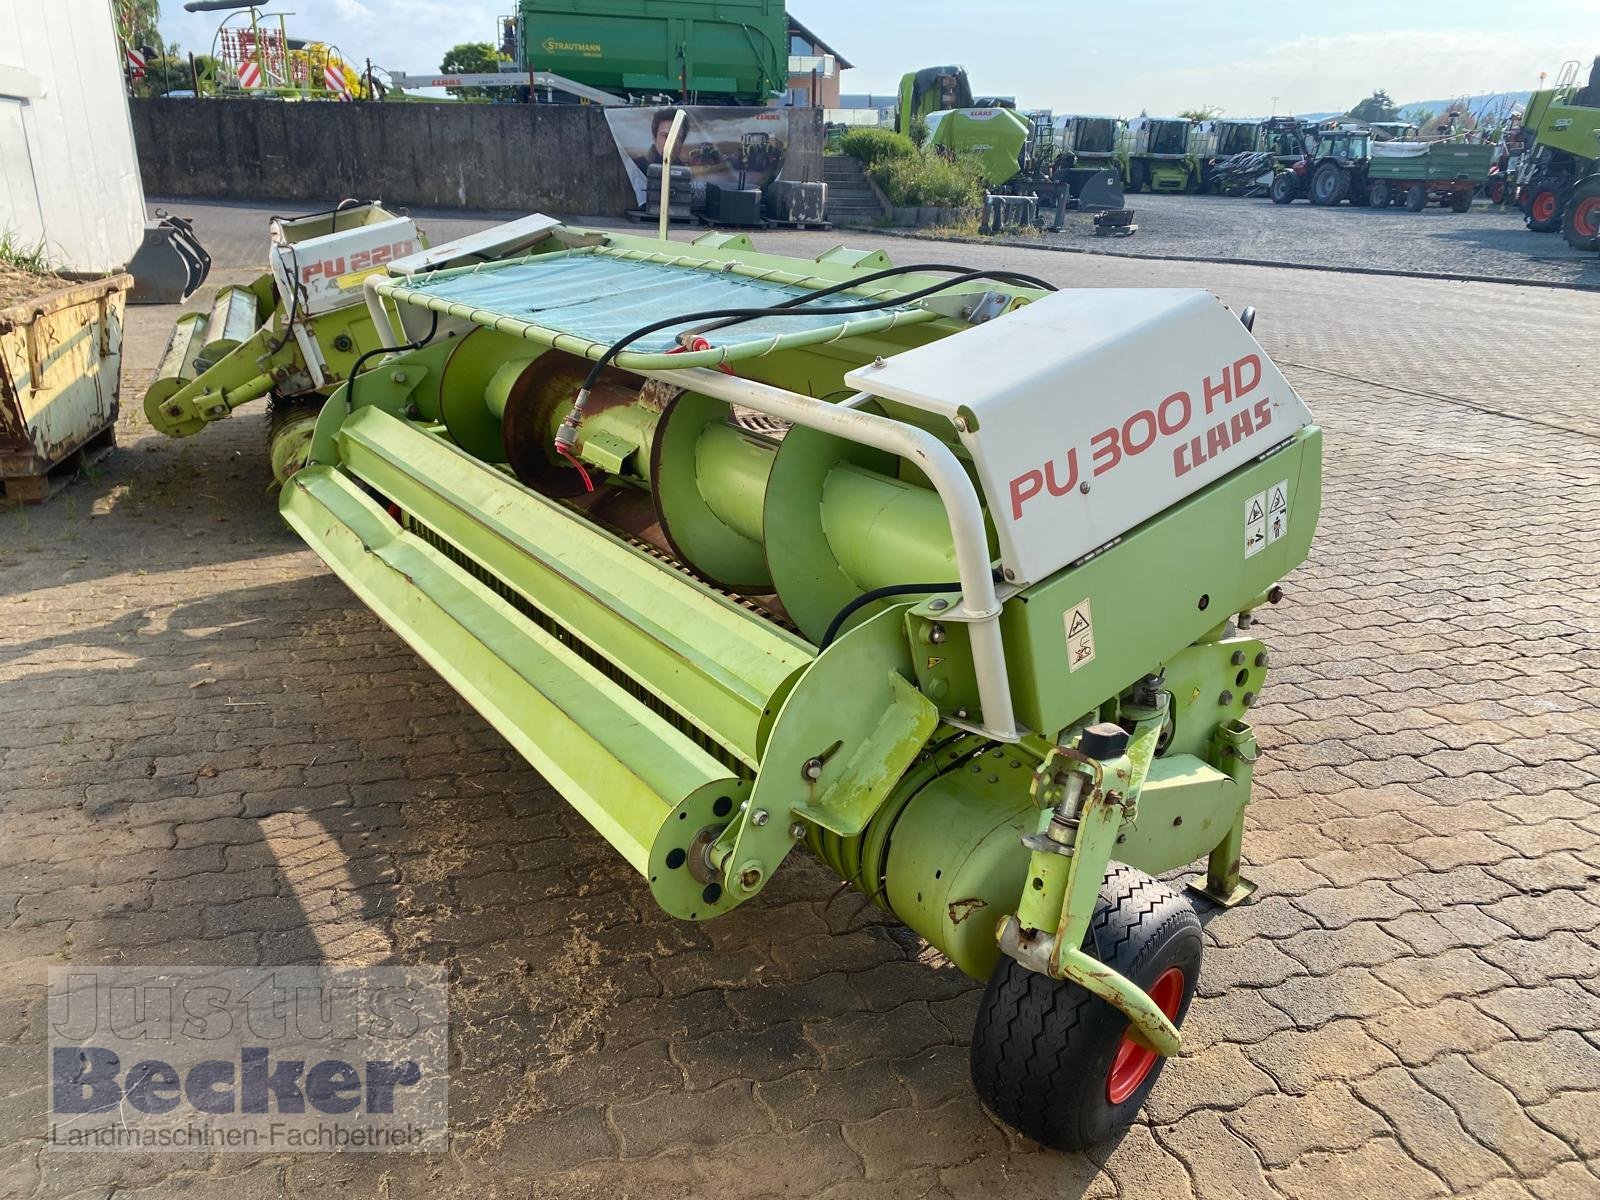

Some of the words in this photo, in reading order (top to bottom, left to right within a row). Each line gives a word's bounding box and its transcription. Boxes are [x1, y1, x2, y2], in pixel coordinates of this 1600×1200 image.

[302, 257, 345, 284] PU
[350, 240, 413, 271] 220
[1009, 447, 1079, 521] PU
[1090, 391, 1192, 477] 300
[1203, 353, 1262, 415] HD
[1173, 397, 1272, 478] CLAAS
